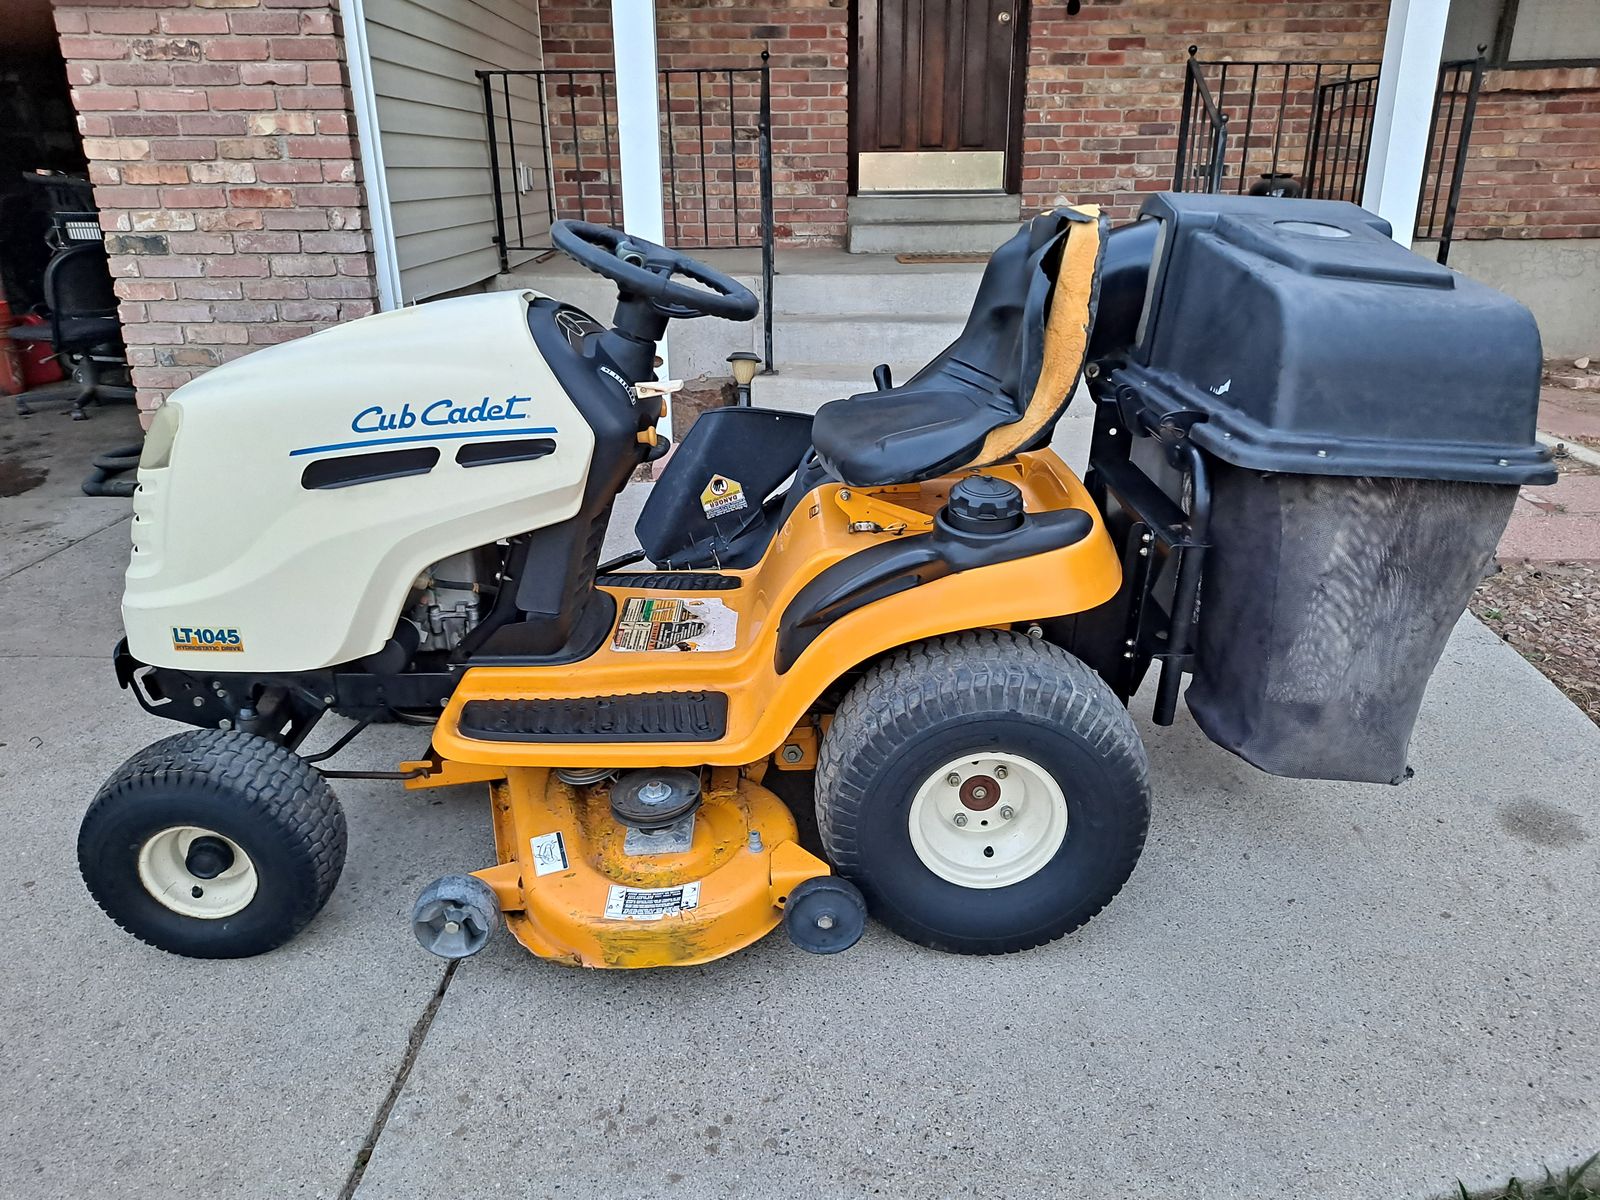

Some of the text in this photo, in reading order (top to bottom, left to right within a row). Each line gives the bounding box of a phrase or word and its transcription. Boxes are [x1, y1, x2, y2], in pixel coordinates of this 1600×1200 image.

[351, 395, 531, 433] Cub Cadet
[709, 494, 738, 508] DANGER
[172, 627, 240, 644] LT1045
